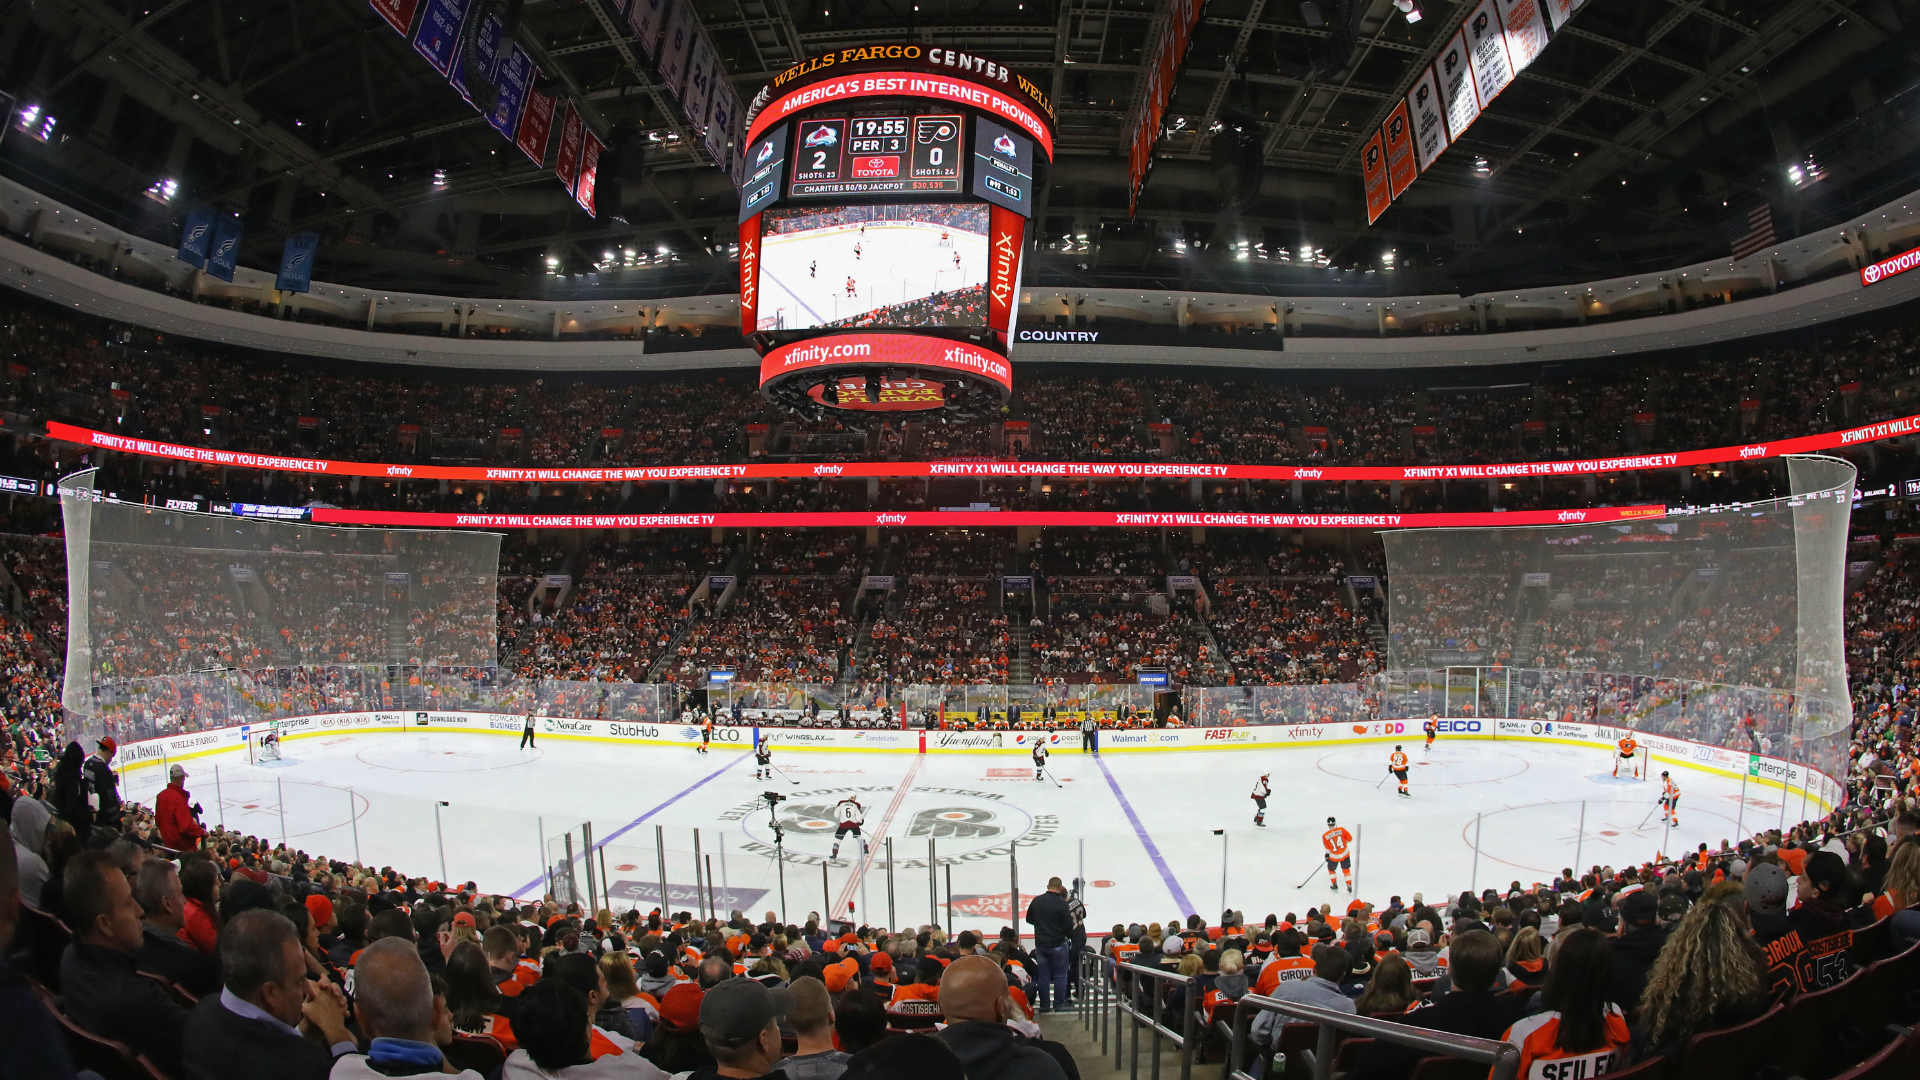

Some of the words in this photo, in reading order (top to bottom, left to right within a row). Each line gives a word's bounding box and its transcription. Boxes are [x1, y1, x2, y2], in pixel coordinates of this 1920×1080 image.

[774, 53, 835, 88] WELLS
[839, 45, 921, 63] FARGO
[929, 48, 1009, 83] CENTER
[693, 63, 707, 97] 24
[1016, 74, 1054, 121] WELLS
[781, 80, 859, 113] AMERICA'S
[863, 78, 906, 91] BEST
[910, 79, 990, 105] INTERNET
[992, 97, 1043, 139] PROVIDER
[715, 101, 728, 133] 32
[855, 120, 905, 136] 19:55
[853, 140, 880, 152] PER
[890, 139, 899, 150] 3
[812, 151, 827, 170] 2
[930, 147, 943, 166] 0
[857, 168, 895, 177] TOYOTA
[992, 158, 1015, 174] PENALTY
[798, 172, 825, 180] SHOTS:
[826, 171, 836, 179] 23
[804, 185, 844, 193] CHARITIES
[845, 183, 868, 192] 50/50
[868, 182, 904, 191] JACKPOT
[183, 242, 203, 256] SOUL
[213, 256, 232, 270] SOUL
[991, 230, 1015, 308] xfinity
[1880, 250, 1920, 276] TOYOTA
[281, 271, 306, 281] SOUL
[741, 238, 756, 310] xfinity
[1019, 330, 1099, 342] COUNTRY
[784, 341, 871, 366] xfinity.com
[944, 347, 1007, 378] xfinity.com
[1840, 426, 1876, 444] XFINITY
[1876, 423, 1888, 437] X1
[1888, 420, 1913, 434] WILL
[91, 432, 125, 449] XFINITY
[124, 439, 136, 451] X1
[136, 440, 158, 454] WILL
[158, 444, 196, 459] CHANGE
[196, 449, 215, 461] THE
[215, 451, 236, 463] WAY
[236, 453, 256, 466] YOU
[256, 456, 315, 470] EXPERIENCE
[314, 461, 328, 471] TV
[1739, 444, 1767, 459] xfinity
[386, 465, 413, 477] xfinity
[486, 469, 524, 480] XFINITY
[525, 469, 537, 479] X1
[537, 469, 561, 479] WILL
[561, 469, 603, 480] CHANGE
[603, 468, 624, 479] THE
[624, 468, 646, 479] WAY
[646, 468, 668, 478] YOU
[668, 466, 731, 478] EXPERIENCE
[732, 466, 747, 476] TV
[813, 464, 844, 476] xfinity
[929, 464, 974, 474] XFINITY
[975, 464, 988, 474] X1
[989, 464, 1018, 474] WILL
[1019, 463, 1067, 474] CHANGE
[1067, 464, 1091, 474] THE
[1091, 464, 1117, 474] WAY
[1118, 464, 1142, 475] YOU
[1144, 464, 1212, 476] EXPERIENCE
[1213, 466, 1228, 476] TV
[1403, 467, 1445, 478] XFINITY
[1445, 467, 1458, 477] X1
[1458, 466, 1485, 477] WILL
[1485, 464, 1529, 476] CHANGE
[1529, 463, 1551, 474] THE
[1551, 462, 1575, 473] WAY
[1575, 460, 1598, 472] YOU
[1599, 455, 1663, 470] EXPERIENCE
[1663, 454, 1677, 465] TV
[1294, 468, 1323, 480] xfinity
[30, 483, 36, 491] 3
[46, 483, 54, 496] 0
[1864, 488, 1887, 497] AVALANCHE
[1888, 483, 1896, 497] 2
[165, 498, 199, 511] FLYERS
[1836, 495, 1845, 503] 23
[876, 512, 907, 525] xfinity
[1116, 513, 1160, 524] XFINITY
[1160, 514, 1173, 524] X1
[1175, 514, 1203, 524] WILL
[1203, 514, 1249, 525] CHANGE
[1249, 515, 1271, 525] THE
[1272, 515, 1295, 525] WAY
[1296, 515, 1319, 526] YOU
[1320, 515, 1386, 526] EXPERIENCE
[1386, 515, 1401, 525] TV
[1557, 510, 1587, 523] xfinity
[1620, 509, 1642, 517] WELLS
[1643, 508, 1664, 516] FARGO
[456, 515, 494, 525] XFINITY
[494, 515, 506, 525] X1
[507, 516, 532, 526] WILL
[532, 516, 573, 526] CHANGE
[573, 516, 594, 526] THE
[594, 516, 617, 526] WAY
[617, 516, 638, 526] YOU
[639, 515, 700, 526] EXPERIENCE
[701, 515, 715, 525] TV
[269, 716, 310, 730] enterprise
[489, 714, 521, 723] COMCAST
[556, 719, 592, 732] NovaCare
[490, 721, 522, 731] BUSINESS
[610, 723, 659, 738] StubHub
[1288, 724, 1324, 739] xfinity
[1557, 724, 1582, 732] Rothman
[1595, 725, 1612, 740] JACK
[866, 734, 900, 742] Constellation
[934, 731, 993, 748] Yuengling
[1111, 734, 1147, 742] Walmart
[1160, 734, 1178, 742] com
[1563, 731, 1588, 739] Jefferson
[170, 741, 194, 750] WELLS
[195, 735, 218, 746] FARGO
[1642, 739, 1664, 751] WELLS
[1664, 743, 1688, 755] FARGO
[1392, 756, 1403, 765] 28
[844, 806, 852, 819] 6
[739, 841, 851, 868] WELLS
[875, 847, 1012, 871] FARGO
[1012, 814, 1060, 848] CENTER
[1329, 835, 1345, 851] 14
[1761, 929, 1804, 966] GIROUX
[1816, 949, 1849, 988] 53
